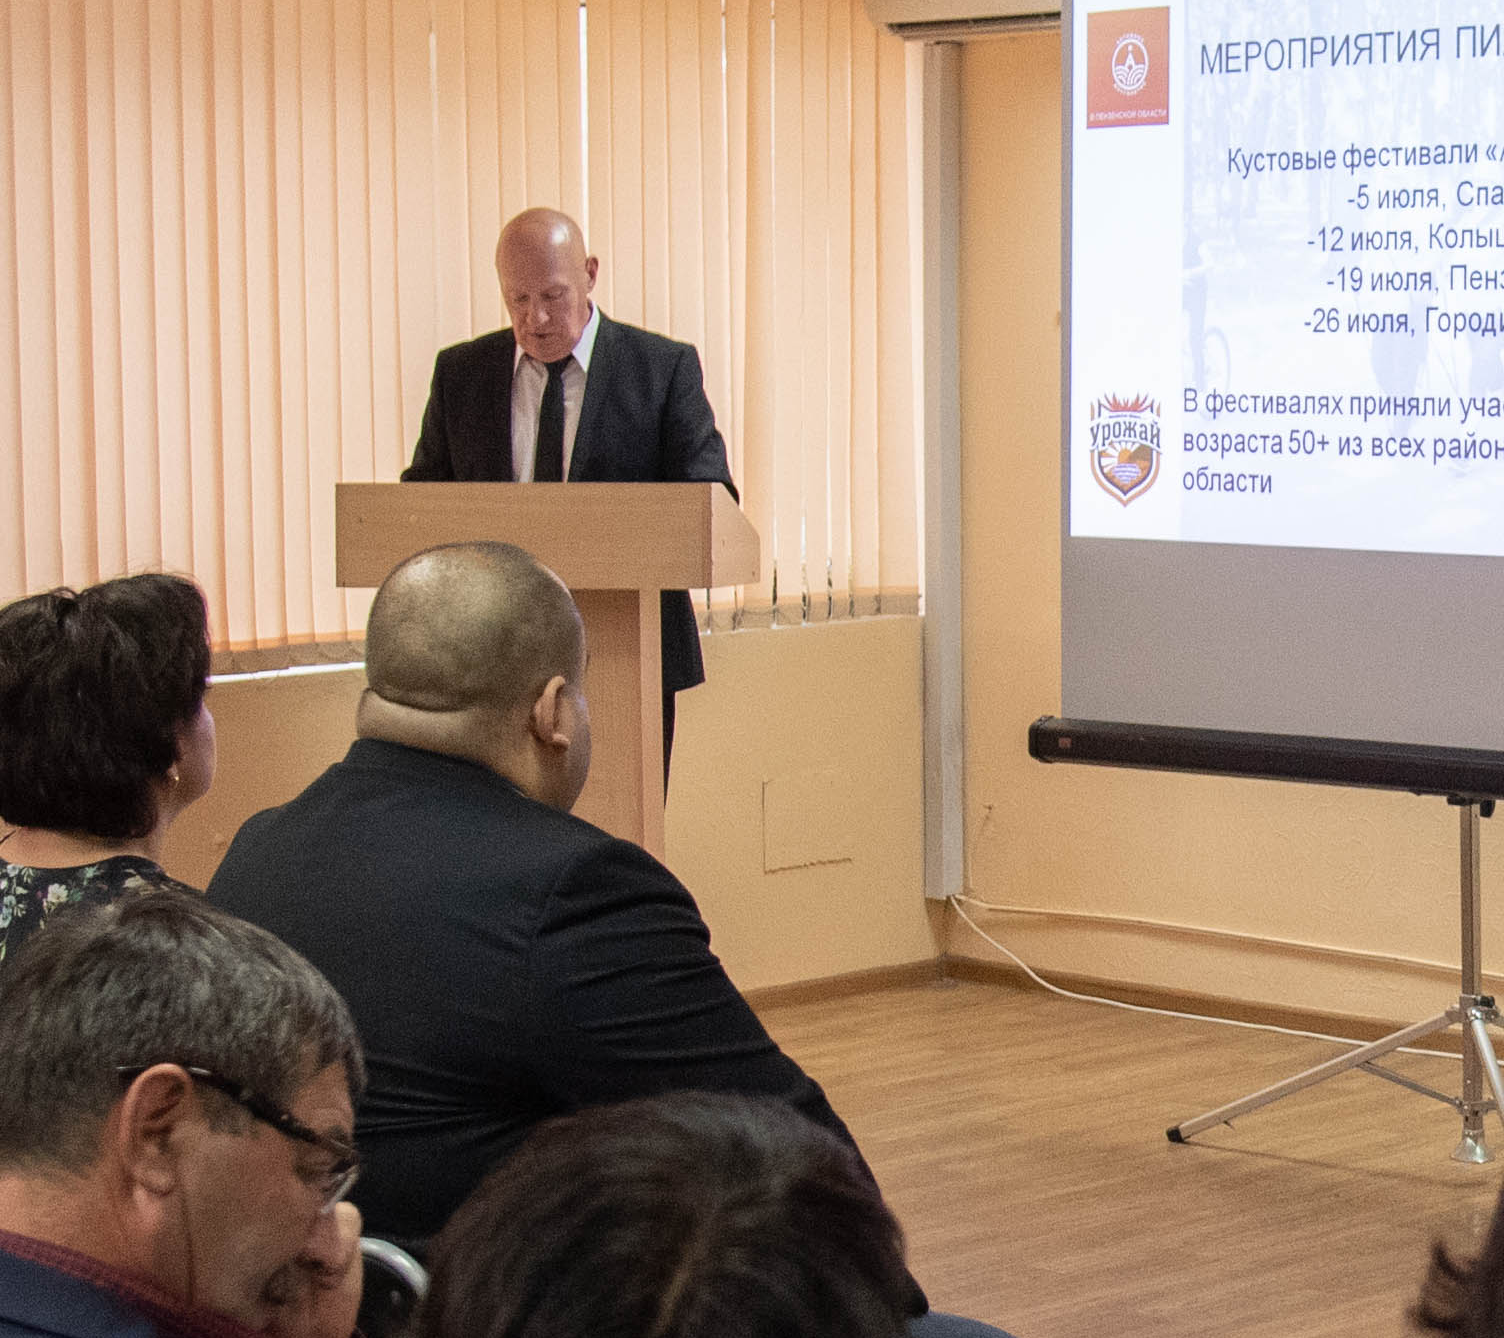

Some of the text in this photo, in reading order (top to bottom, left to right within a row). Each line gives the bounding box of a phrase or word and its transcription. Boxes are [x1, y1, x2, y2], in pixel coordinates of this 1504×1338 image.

[1200, 27, 1440, 75] МЕРОПРИЯТИЯ
[1227, 147, 1337, 180] Кустовые
[1342, 143, 1478, 176] фестивали
[1347, 183, 1370, 210] -5
[1377, 187, 1446, 212] июля,
[1307, 226, 1344, 252] -12
[1351, 230, 1419, 253] июля,
[1326, 266, 1363, 292] -19
[1371, 271, 1439, 294] июля,
[1304, 307, 1340, 333] -26
[1347, 312, 1416, 337] июля,
[1183, 387, 1198, 412] В
[1205, 388, 1344, 420] фестивалях
[1349, 395, 1451, 422] приняли
[1089, 419, 1162, 450] урожай
[1183, 431, 1283, 459] возраста
[1288, 429, 1330, 455] 50+
[1338, 435, 1363, 457] из
[1371, 436, 1425, 458] всех
[1182, 466, 1273, 494] области
